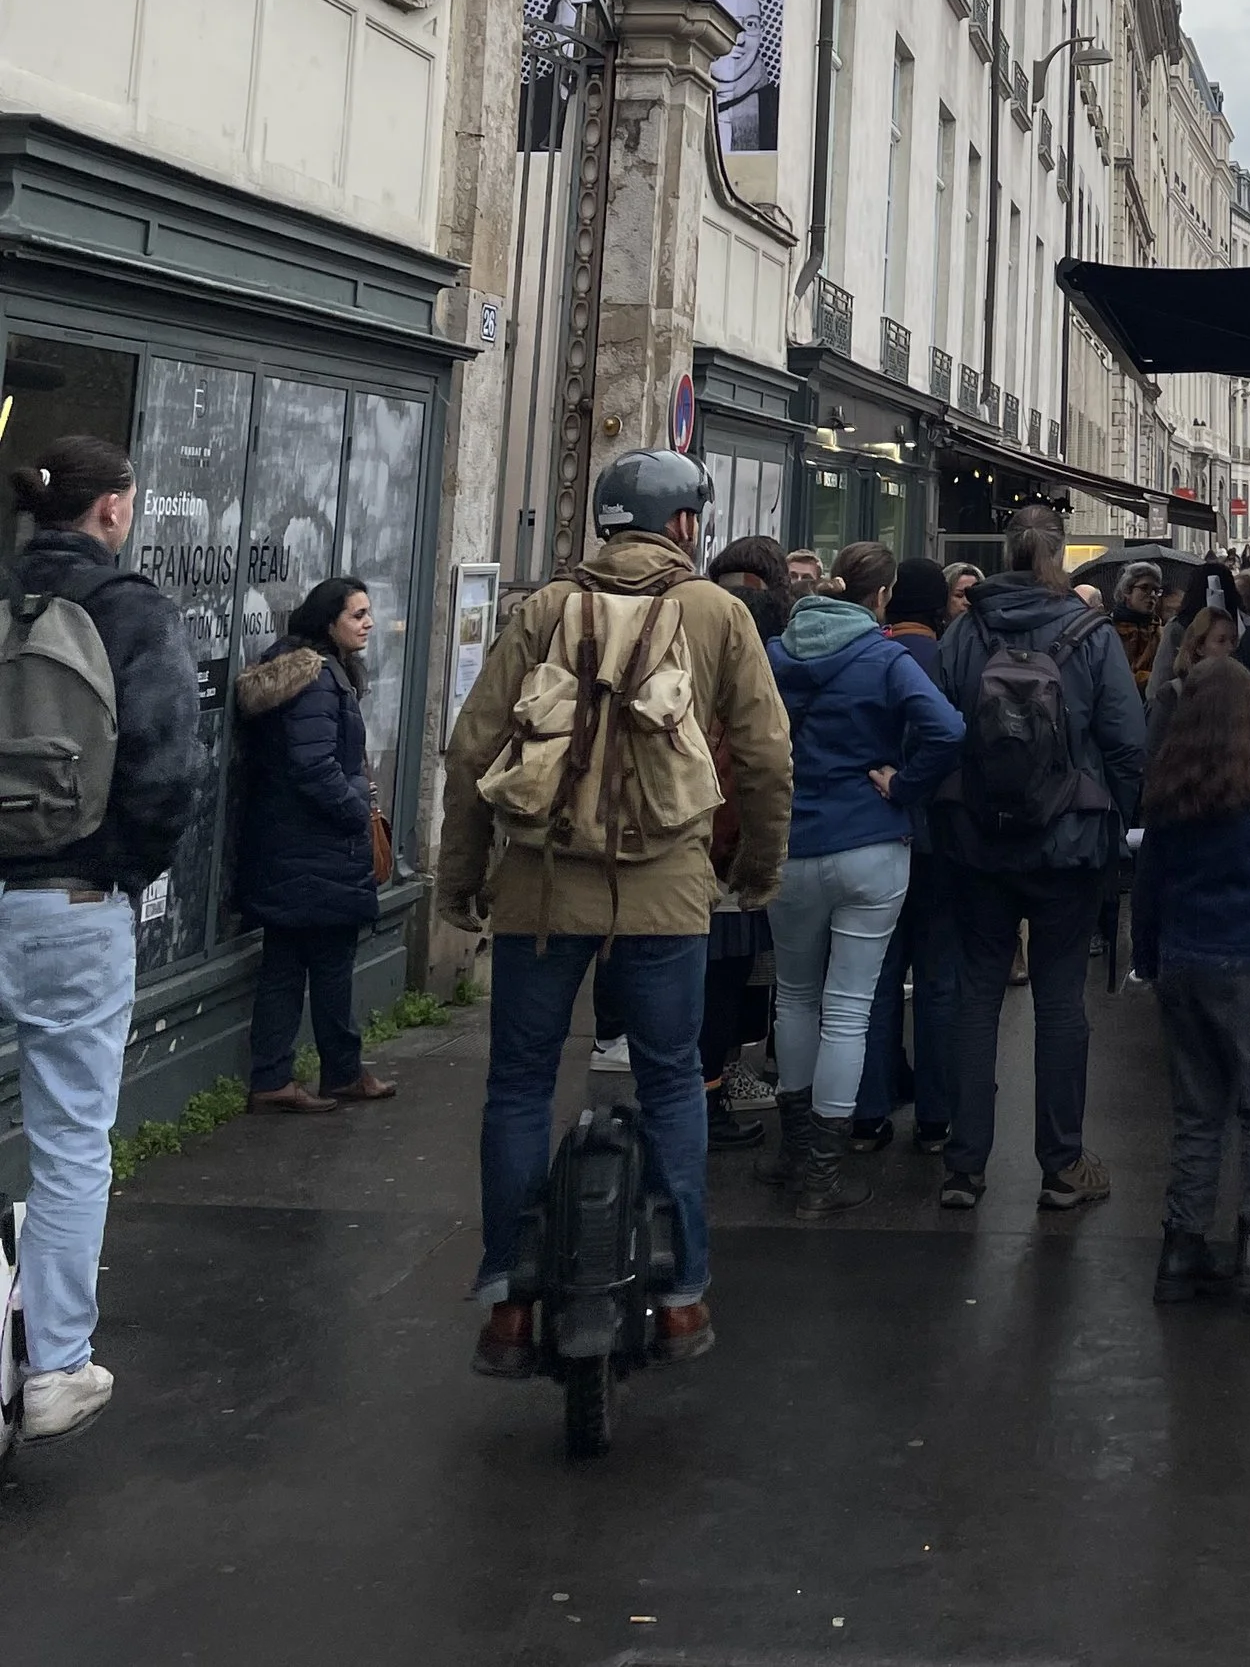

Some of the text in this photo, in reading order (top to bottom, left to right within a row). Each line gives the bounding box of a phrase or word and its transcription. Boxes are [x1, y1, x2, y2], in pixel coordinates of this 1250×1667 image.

[483, 309, 495, 337] 26
[144, 489, 203, 522] Exposition
[139, 536, 291, 597] FRANÇOIS RÉAU
[215, 613, 231, 639] DE
[242, 612, 262, 636] NOS
